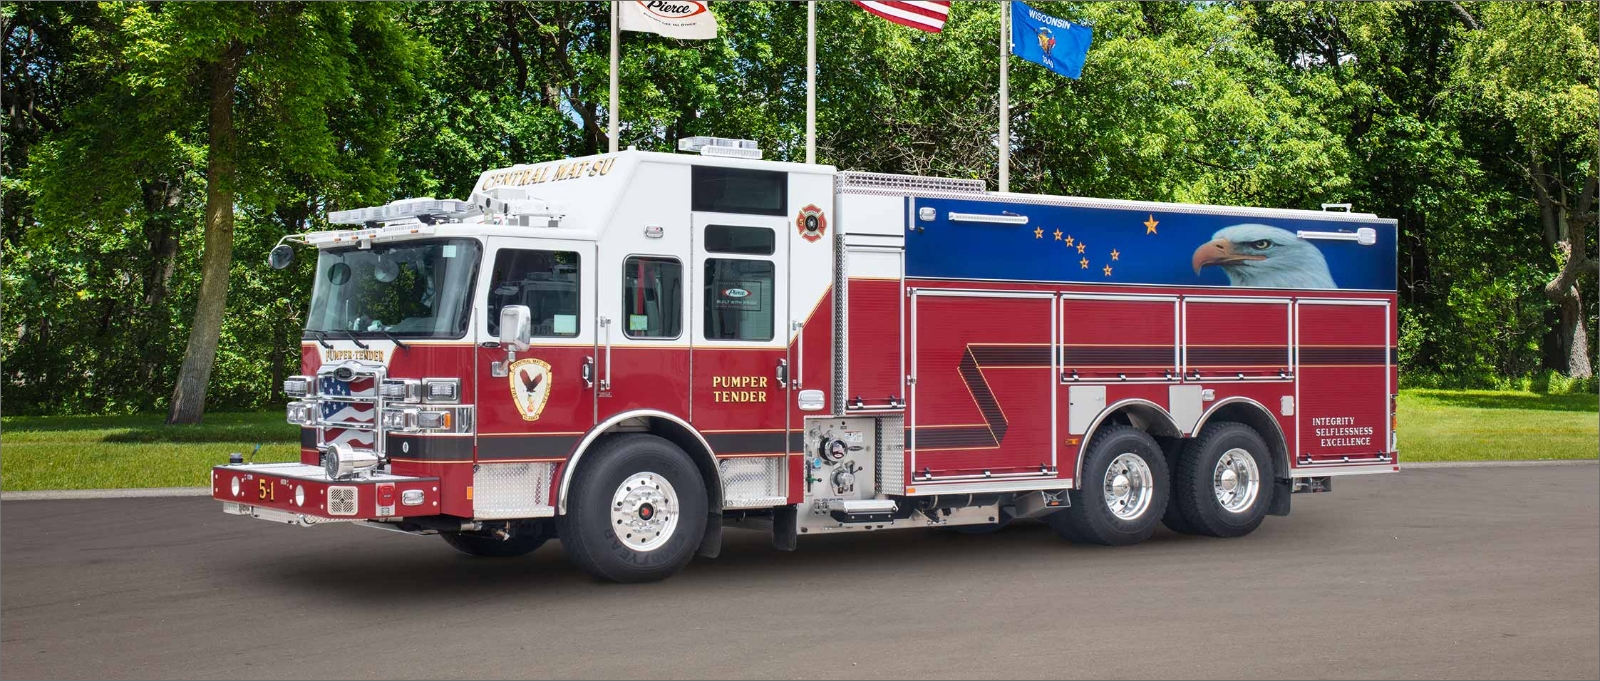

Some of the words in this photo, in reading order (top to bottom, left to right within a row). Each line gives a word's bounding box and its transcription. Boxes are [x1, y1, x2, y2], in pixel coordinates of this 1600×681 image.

[647, 1, 690, 13] Pierce
[1028, 9, 1071, 30] WISCONSIN
[482, 166, 552, 191] CENTRAL
[713, 376, 768, 388] PUMPER
[713, 391, 767, 403] TENDER
[1312, 417, 1355, 426] INTEGRITY
[1315, 427, 1373, 437] SELFLESSNESS
[1321, 437, 1371, 447] EXCELLENCE
